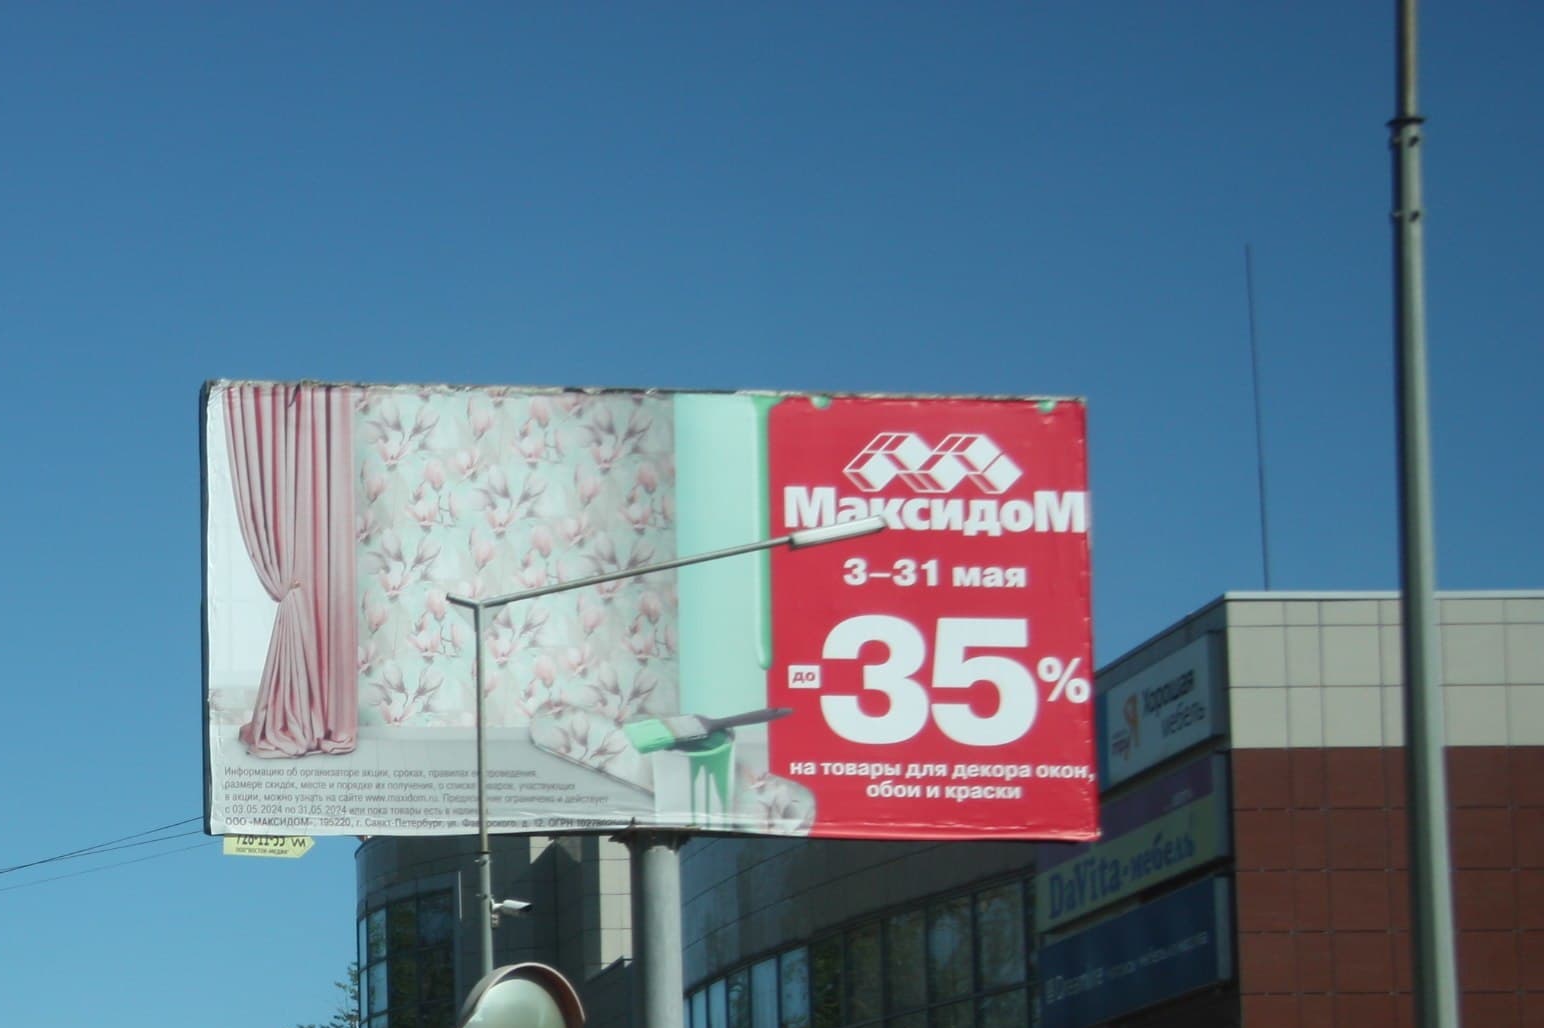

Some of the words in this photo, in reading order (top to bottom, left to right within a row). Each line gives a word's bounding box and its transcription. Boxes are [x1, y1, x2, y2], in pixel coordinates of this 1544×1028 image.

[953, 567, 1027, 588] мая
[792, 669, 816, 684] до
[225, 767, 284, 778] Информацию
[286, 766, 298, 777] об
[300, 769, 360, 778] организаторе
[790, 761, 815, 776] на
[820, 762, 900, 779] товары
[906, 763, 947, 779] для
[952, 764, 1030, 780] декора
[1035, 765, 1096, 784] окон,
[225, 781, 263, 791] размере
[264, 781, 298, 791] скидок,
[337, 782, 374, 791] порядке
[866, 779, 921, 799] обои
[926, 784, 940, 799] и
[945, 784, 1021, 802] краски
[264, 794, 293, 802] можно
[295, 794, 324, 803] узнать
[326, 794, 337, 802] на
[338, 792, 363, 802] сайте
[232, 804, 282, 814] 03.05.2024
[285, 806, 296, 814] по
[297, 804, 347, 815] 31.05.2024
[348, 807, 366, 815] или
[367, 807, 389, 815] пока
[391, 807, 422, 817] товары
[423, 807, 443, 816] есть
[226, 816, 247, 825] ООО
